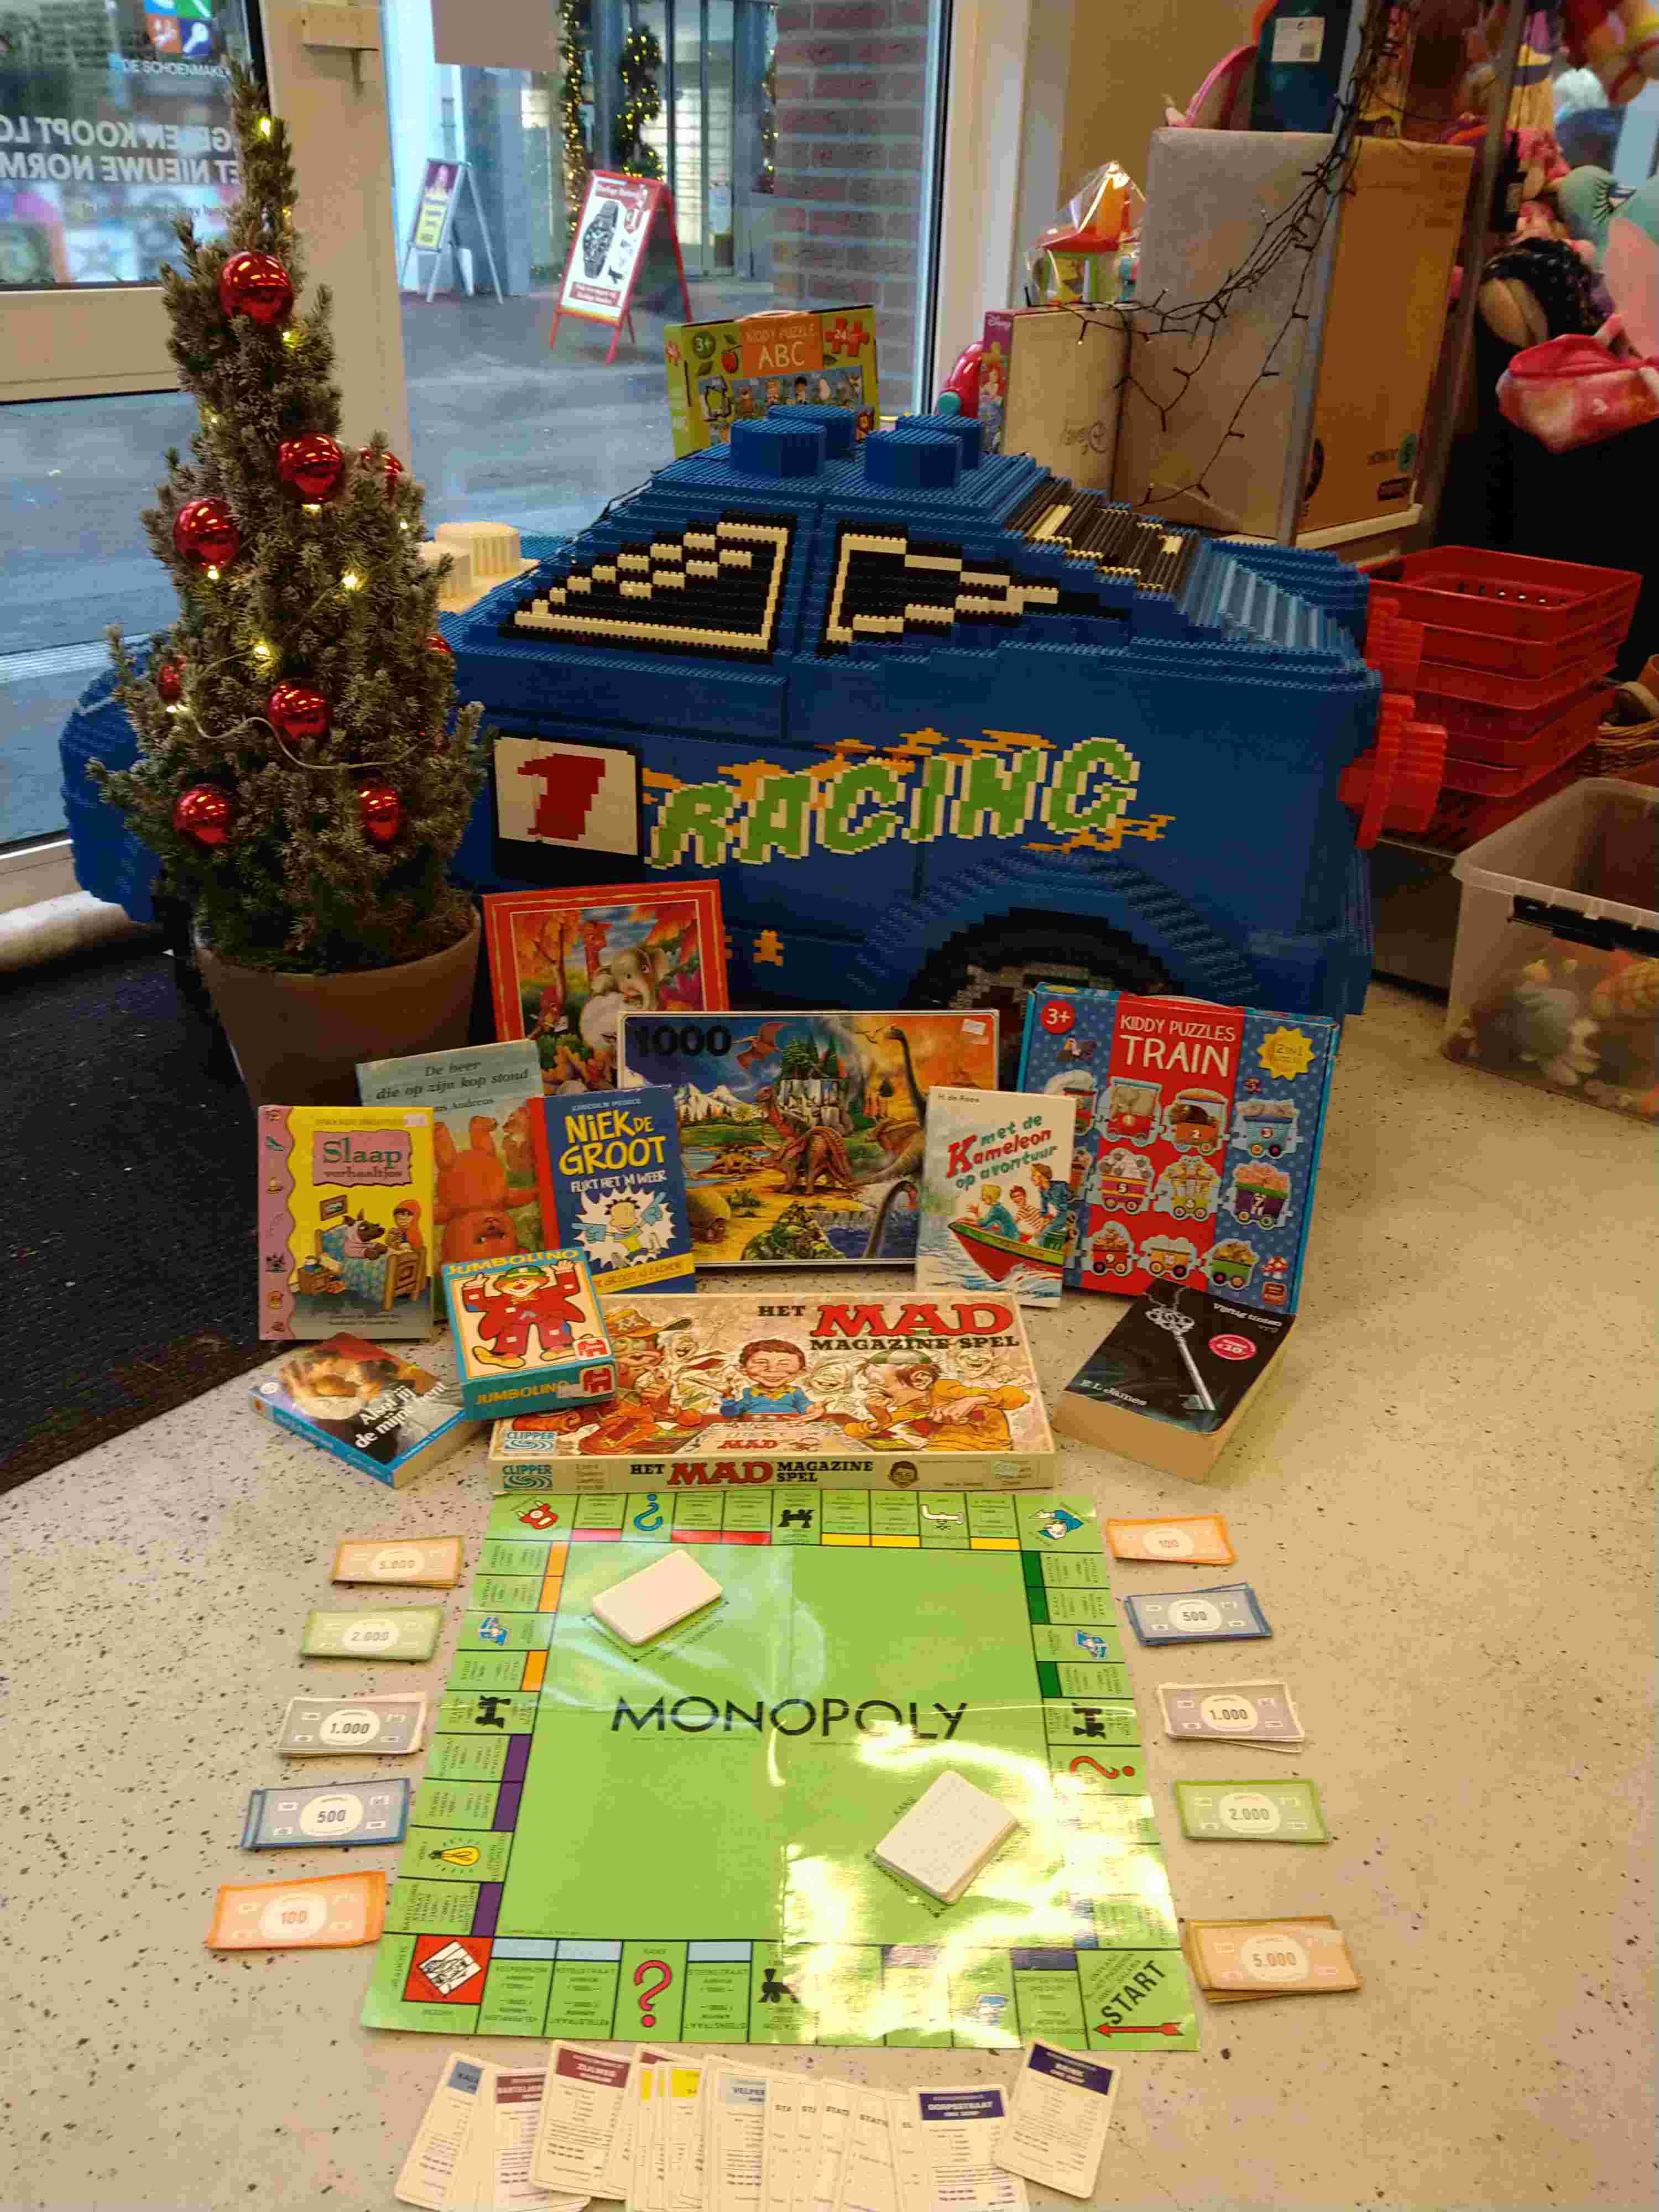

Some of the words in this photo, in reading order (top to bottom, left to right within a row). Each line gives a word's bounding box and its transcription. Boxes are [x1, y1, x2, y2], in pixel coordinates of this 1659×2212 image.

[695, 333, 712, 354] 3+
[758, 341, 806, 371] ABC
[644, 737, 1141, 869] RACING
[1046, 1008, 1072, 1026] 3+
[1120, 1014, 1166, 1035] KIDDY
[1168, 1020, 1237, 1043] PUZZLES
[630, 1024, 732, 1057] 1000
[1119, 1035, 1230, 1078] TRAIN
[424, 1066, 443, 1077] De
[448, 1062, 482, 1074] beer
[375, 1087, 400, 1100] die
[405, 1086, 423, 1098] op
[427, 1081, 455, 1093] zijn
[460, 1076, 487, 1089] kop
[491, 1068, 529, 1084] stond
[632, 1116, 655, 1133] DE
[981, 1121, 1016, 1146] met
[1022, 1115, 1042, 1130] de
[323, 1137, 402, 1169] Slaap
[559, 1136, 668, 1176] GROOT
[946, 1128, 1052, 1178] Kameleon
[600, 1176, 621, 1188] HET
[636, 1170, 668, 1185] WEER
[955, 1174, 976, 1192] op
[980, 1145, 1058, 1180] avontuur
[448, 1249, 579, 1275] JUMBOLINO
[758, 1305, 806, 1317] HET
[810, 1302, 1014, 1338] MAD
[810, 1336, 950, 1351] MAGAZINE
[959, 1335, 1020, 1349] SPEL
[1104, 1386, 1148, 1407] James
[354, 1431, 378, 1449] de
[505, 1431, 556, 1440] CLIPPER
[717, 1439, 779, 1450] MAD
[503, 1464, 552, 1475] CLIPPER
[629, 1463, 665, 1475] HET
[667, 1460, 774, 1486] MAD
[776, 1460, 874, 1472] MAGAZINE
[776, 1472, 819, 1483] SPEL
[1182, 1610, 1208, 1621] 500
[610, 1695, 969, 1740] MONOPOLY
[1209, 1709, 1248, 1721] 1.000
[330, 1723, 371, 1735] 1.000
[317, 1809, 347, 1823] 500
[1228, 1808, 1270, 1820] 2.000
[280, 1910, 309, 1925] 100
[1252, 1952, 1297, 1968] 5.000
[1100, 1959, 1167, 2026] START
